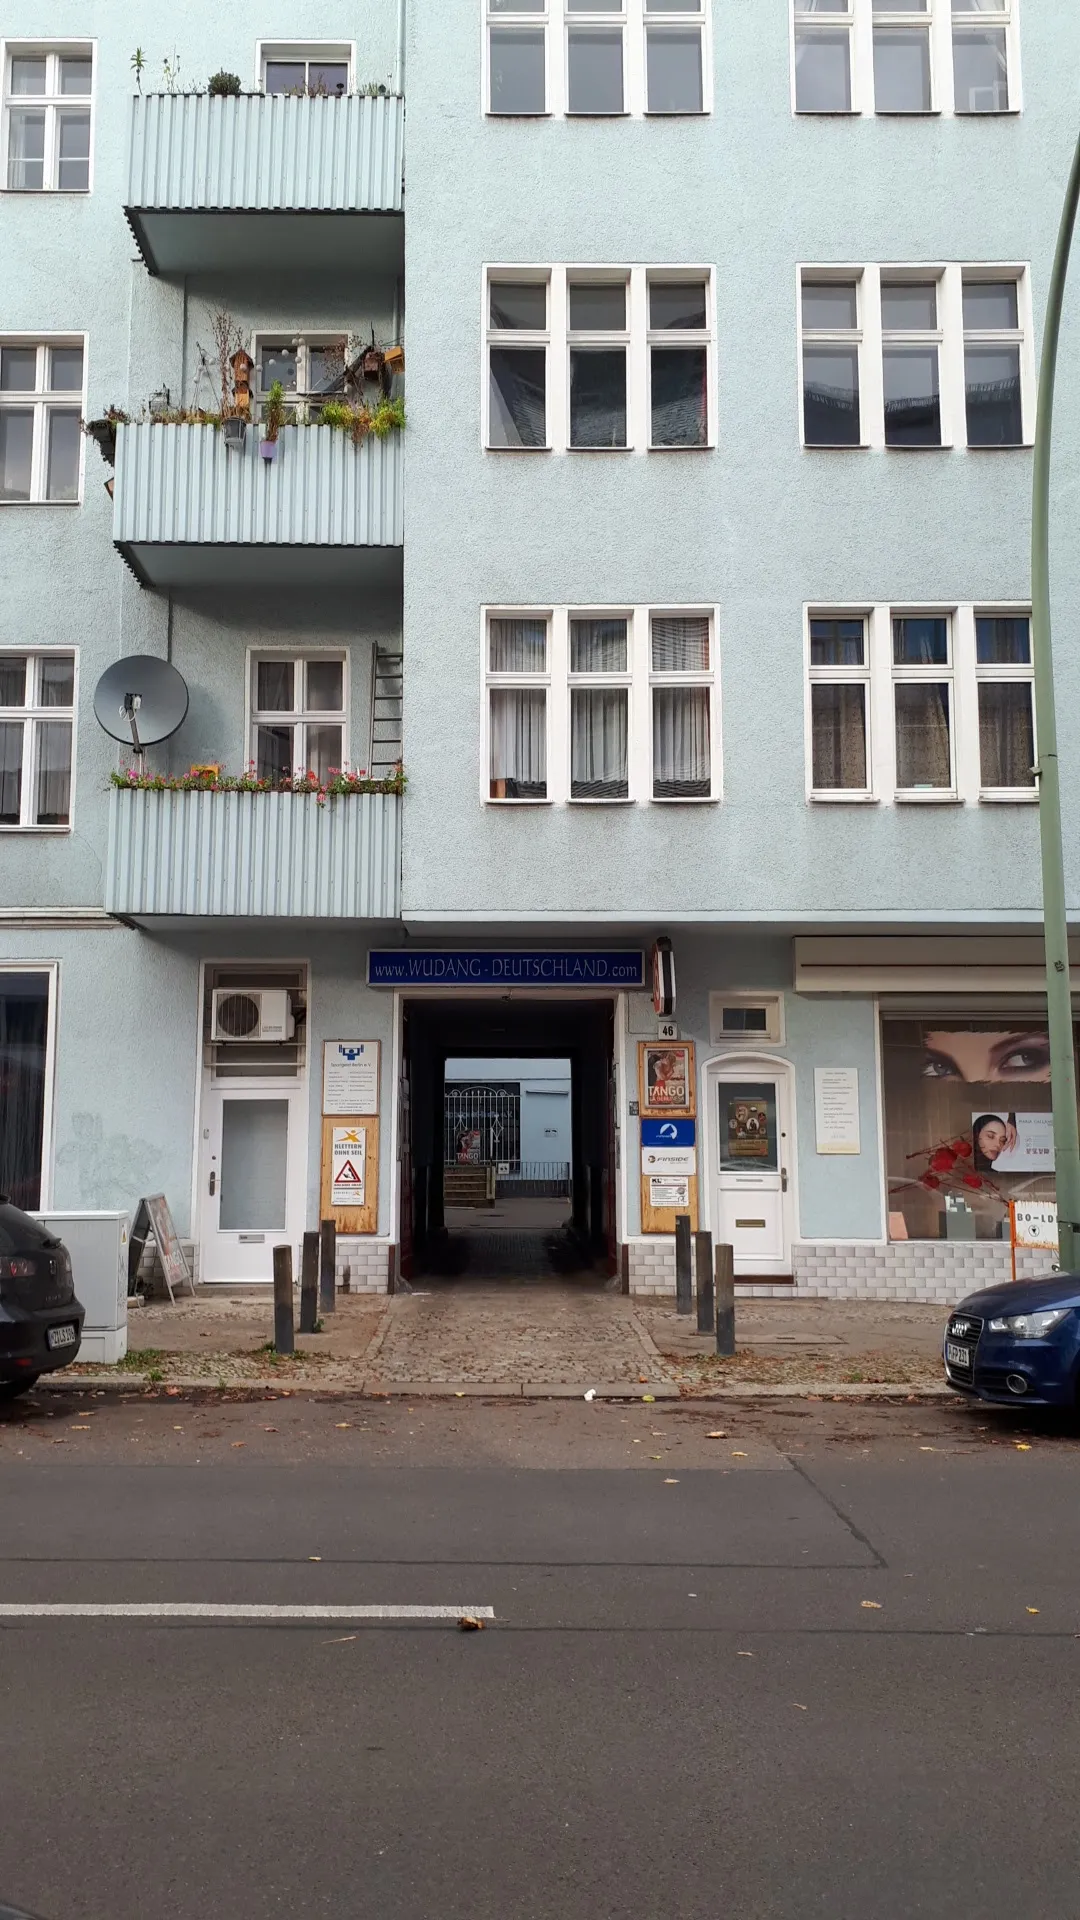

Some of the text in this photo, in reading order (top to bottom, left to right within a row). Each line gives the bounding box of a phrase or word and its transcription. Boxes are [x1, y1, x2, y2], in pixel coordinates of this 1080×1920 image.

[375, 958, 480, 978] www.WUDANG
[492, 958, 637, 978] DEUTSCHLAND.com
[662, 1026, 673, 1036] 46
[648, 1086, 684, 1097] TANGO
[1017, 1213, 1057, 1223] BO-LD
